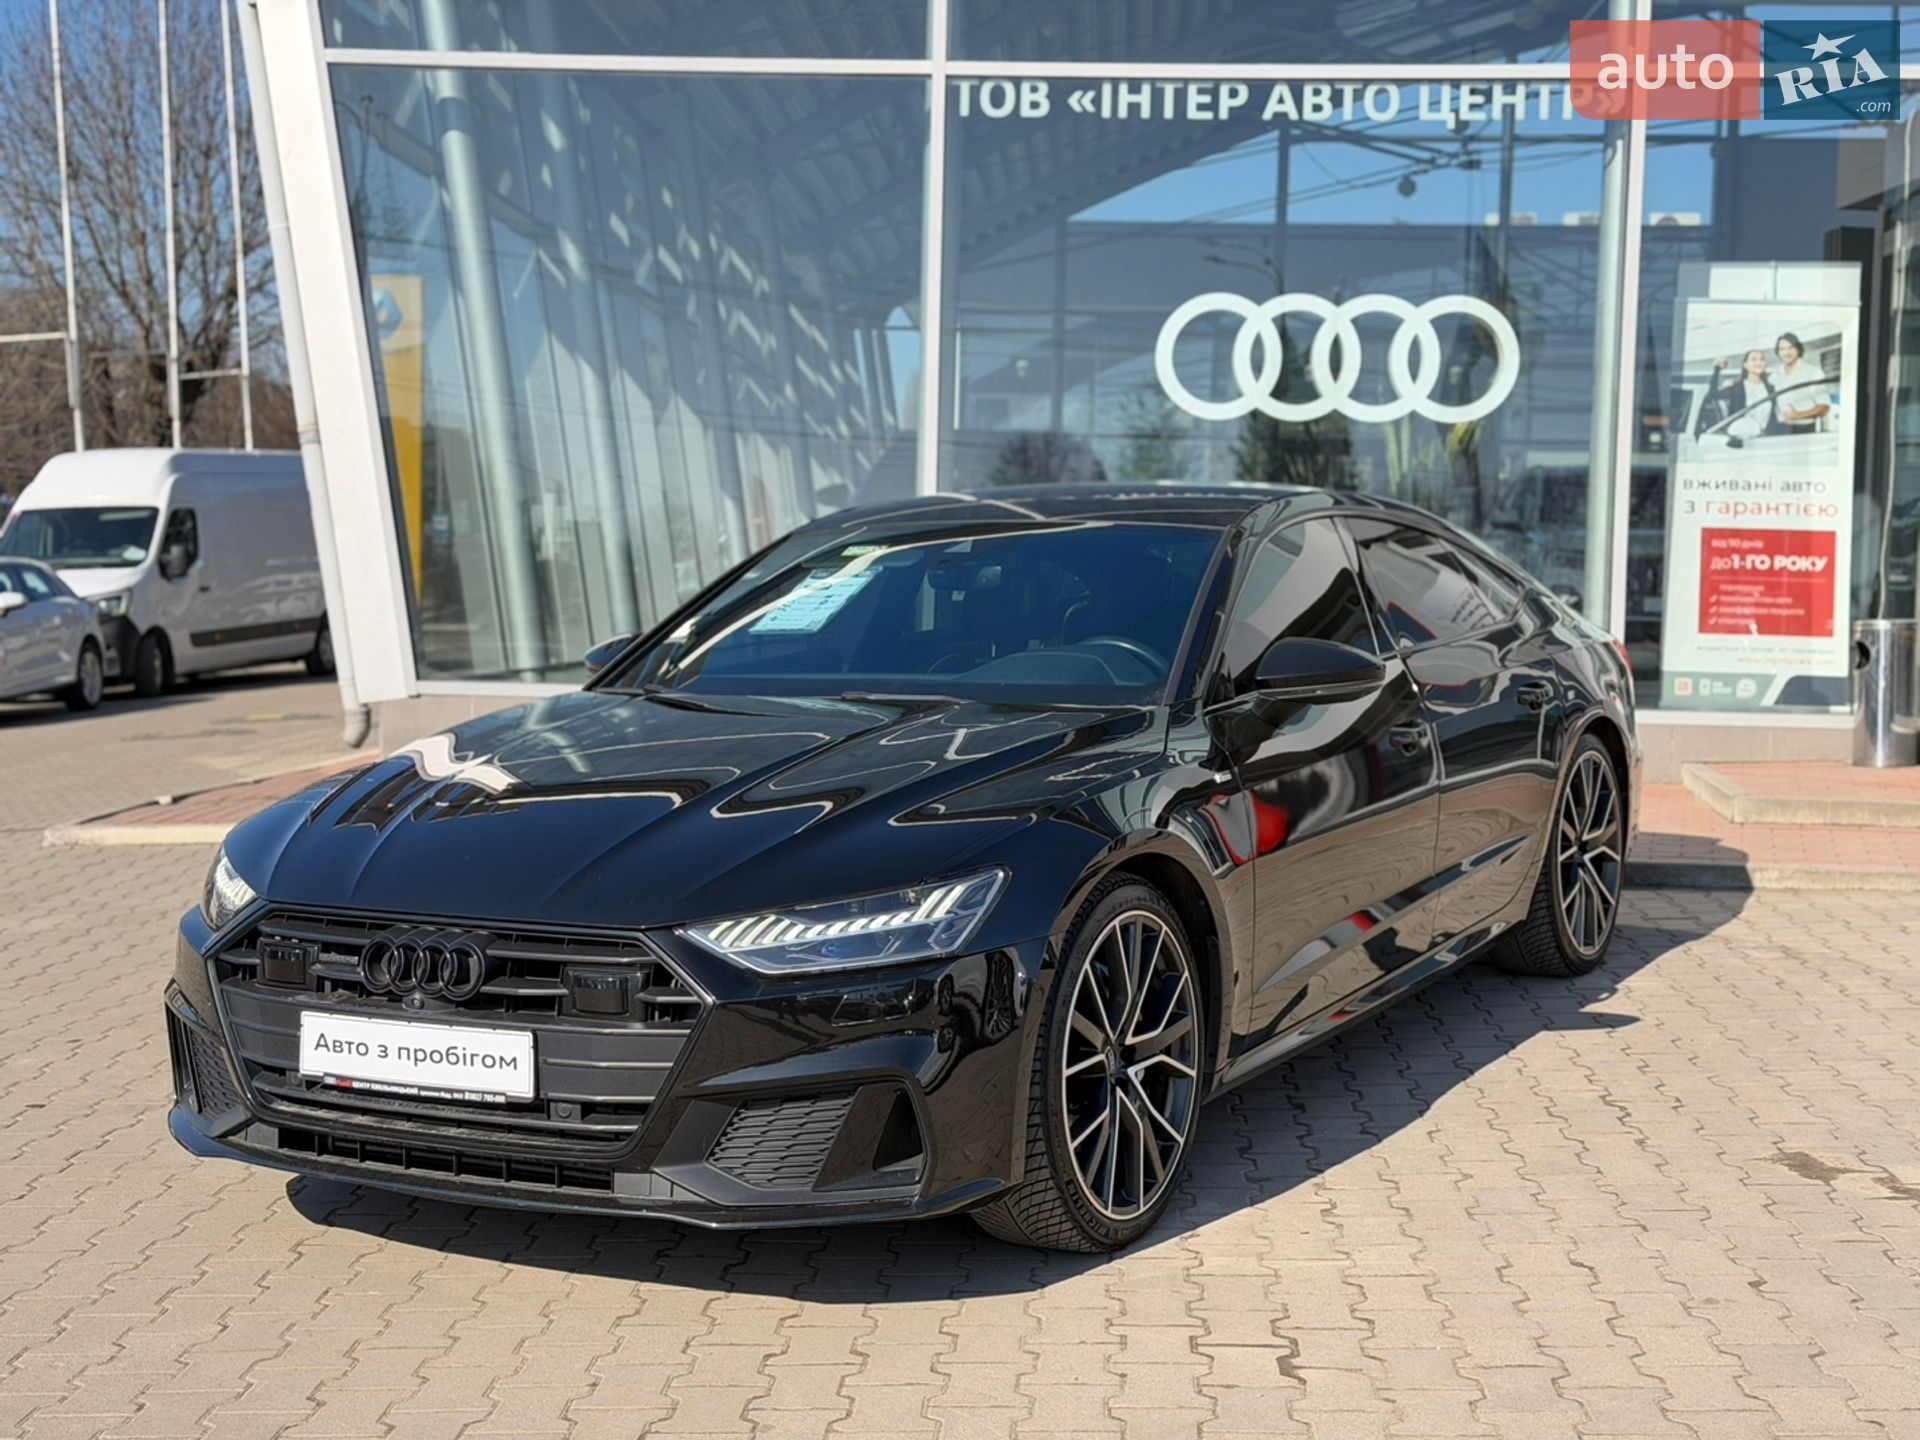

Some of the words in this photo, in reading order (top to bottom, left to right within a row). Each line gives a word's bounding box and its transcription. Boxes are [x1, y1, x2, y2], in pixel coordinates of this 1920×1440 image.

[951, 79, 1051, 118] ТОВ
[1067, 80, 1250, 121] «ІНТЕР
[1261, 82, 1401, 122] АВТО
[1682, 475, 1773, 492] вживані
[1780, 480, 1827, 494] авто
[1683, 499, 1696, 515] з
[1705, 497, 1839, 519] гарантією
[1772, 554, 1828, 573] РОКУ
[314, 1032, 369, 1057] Авто
[377, 1043, 389, 1059] з
[397, 1045, 518, 1071] пробігом
